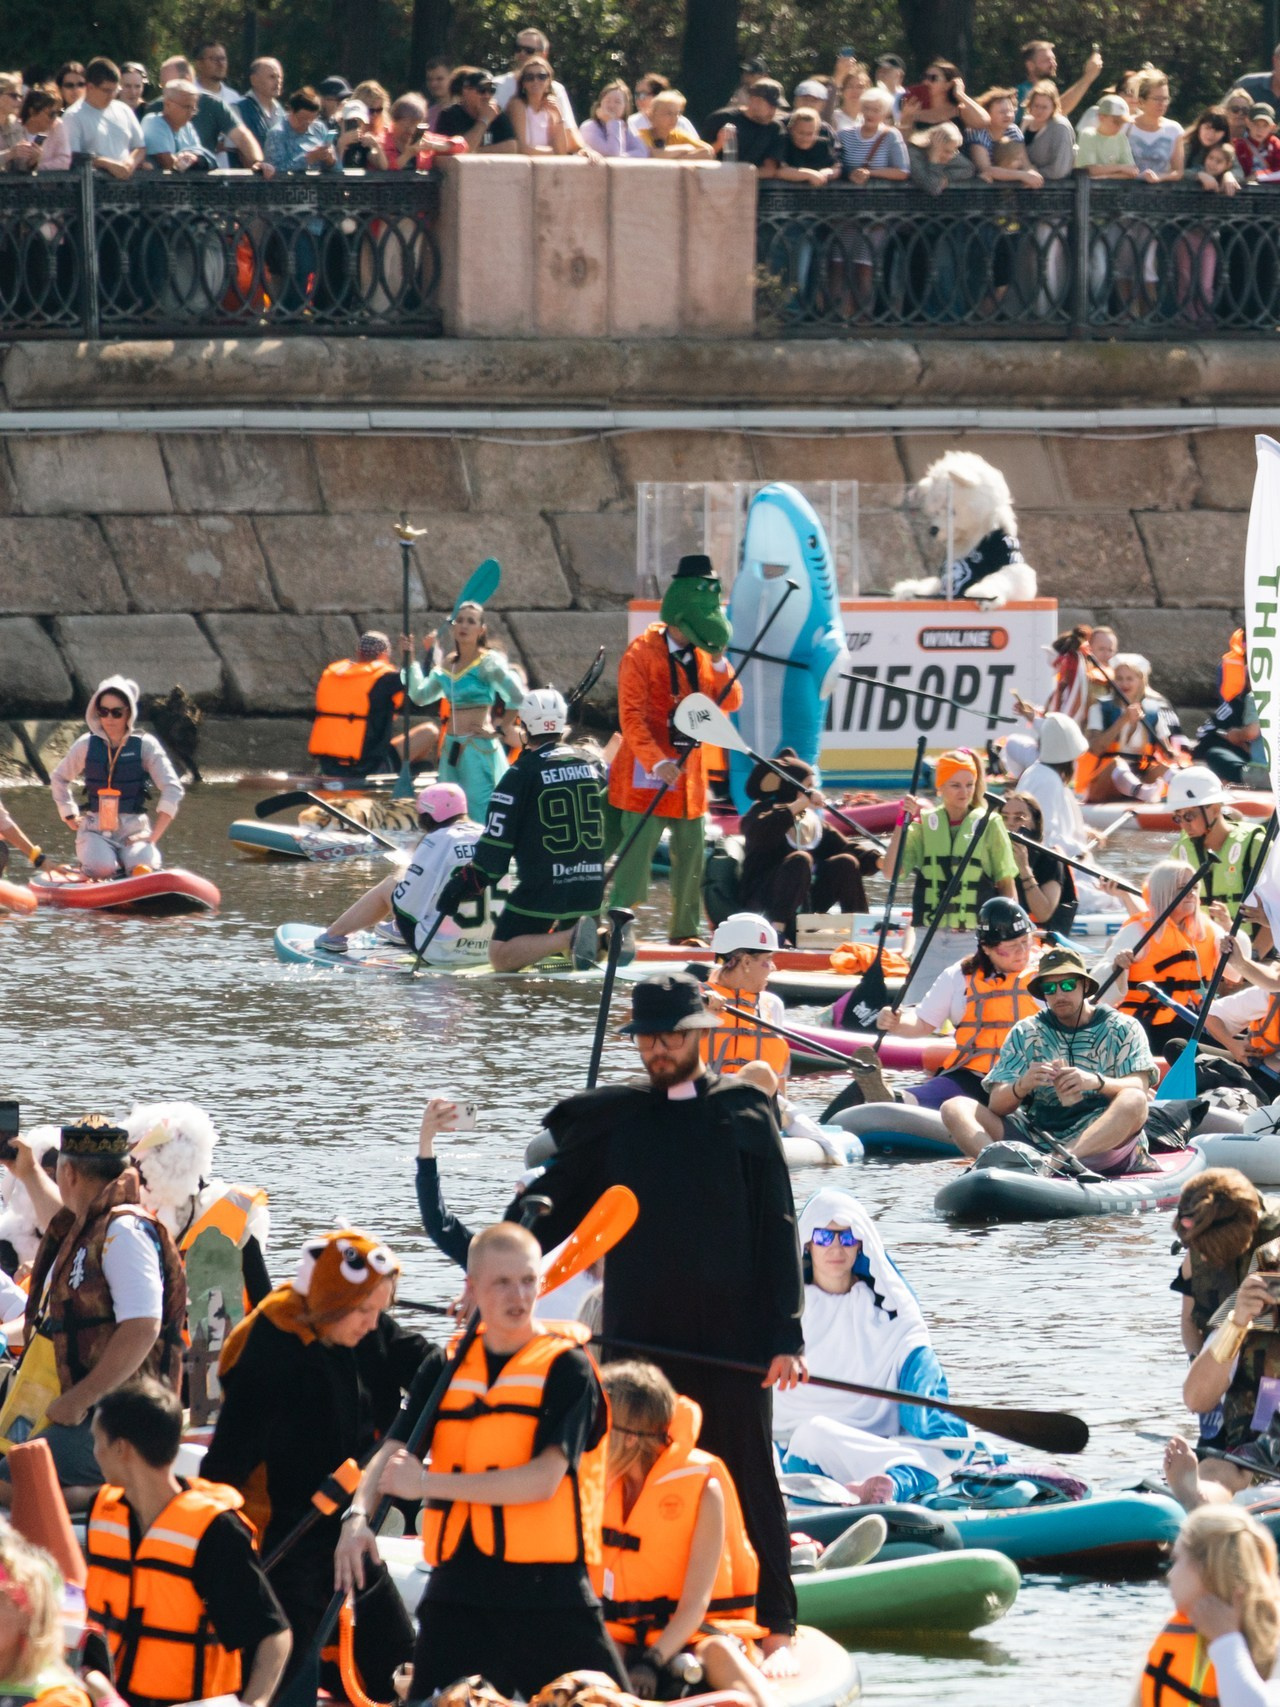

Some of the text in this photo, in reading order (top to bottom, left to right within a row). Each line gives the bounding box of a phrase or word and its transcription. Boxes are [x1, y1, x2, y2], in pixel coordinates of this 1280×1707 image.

[922, 631, 991, 648] WINLINE
[823, 664, 1015, 732] ПБОРТ
[543, 720, 556, 732] 95
[537, 783, 605, 854] 95
